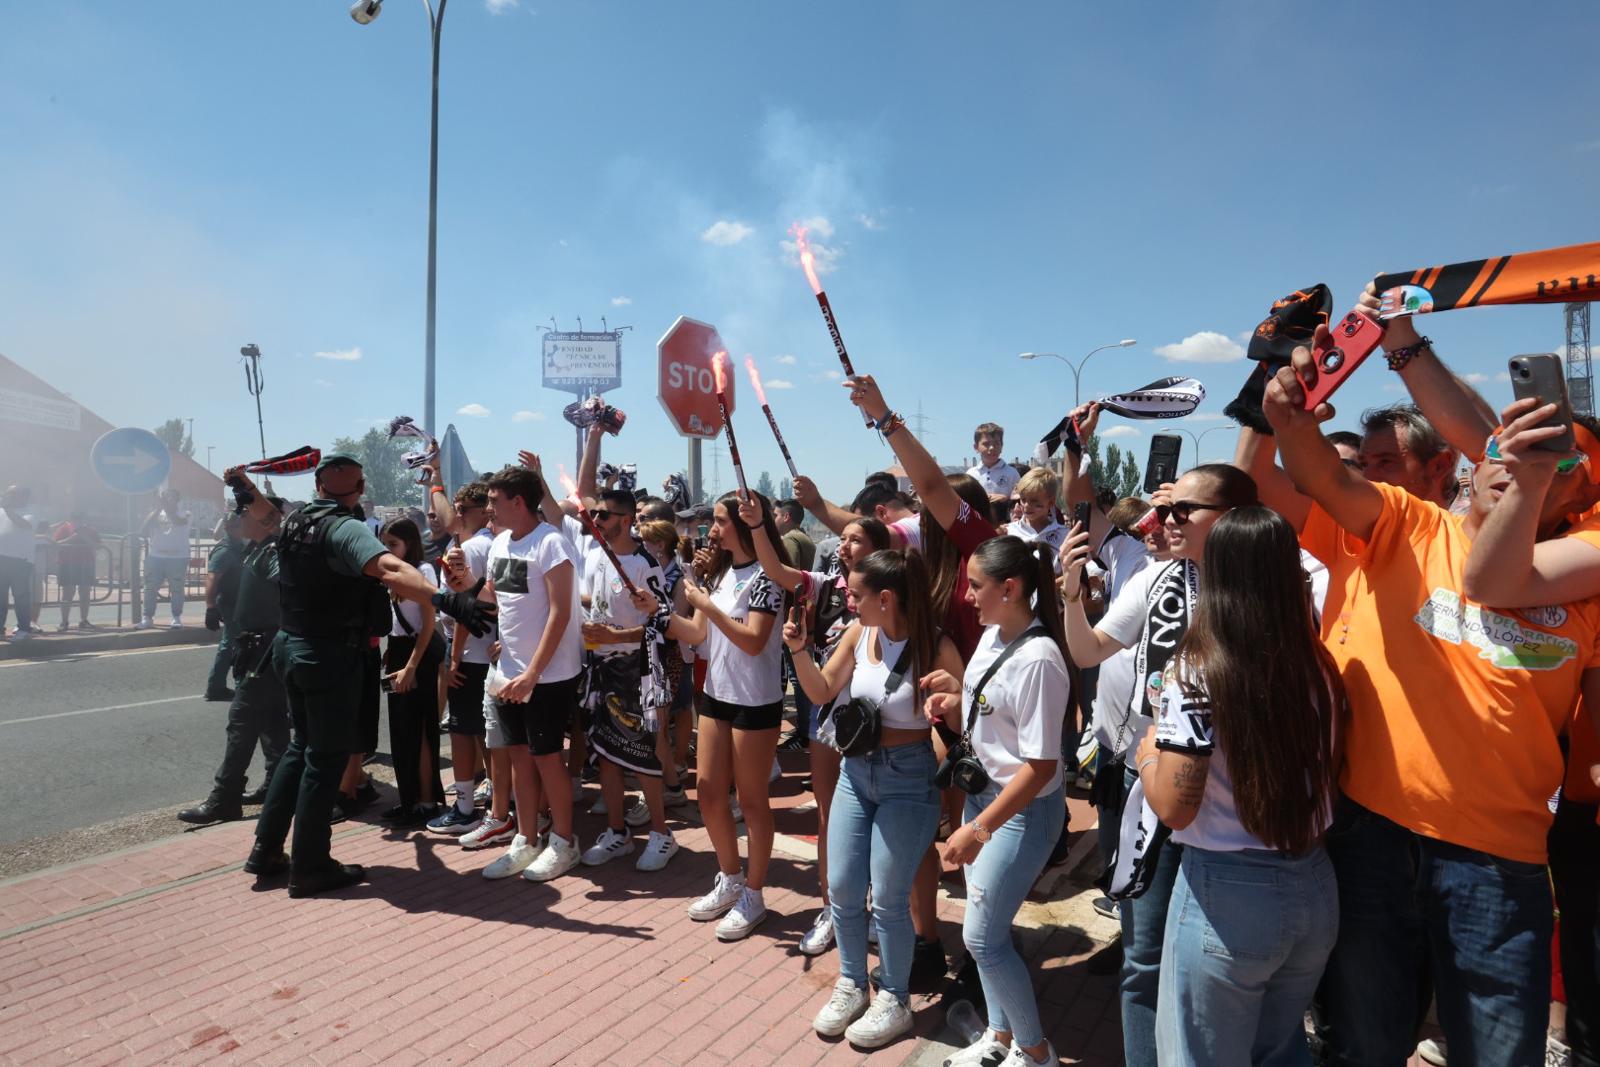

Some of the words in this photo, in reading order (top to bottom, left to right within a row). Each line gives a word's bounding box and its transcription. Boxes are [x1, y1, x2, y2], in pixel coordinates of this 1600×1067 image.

[1425, 599, 1492, 636] FERNANDO
[1494, 628, 1541, 654] LÓPEZ
[1493, 615, 1577, 654] DECRACIÓN
